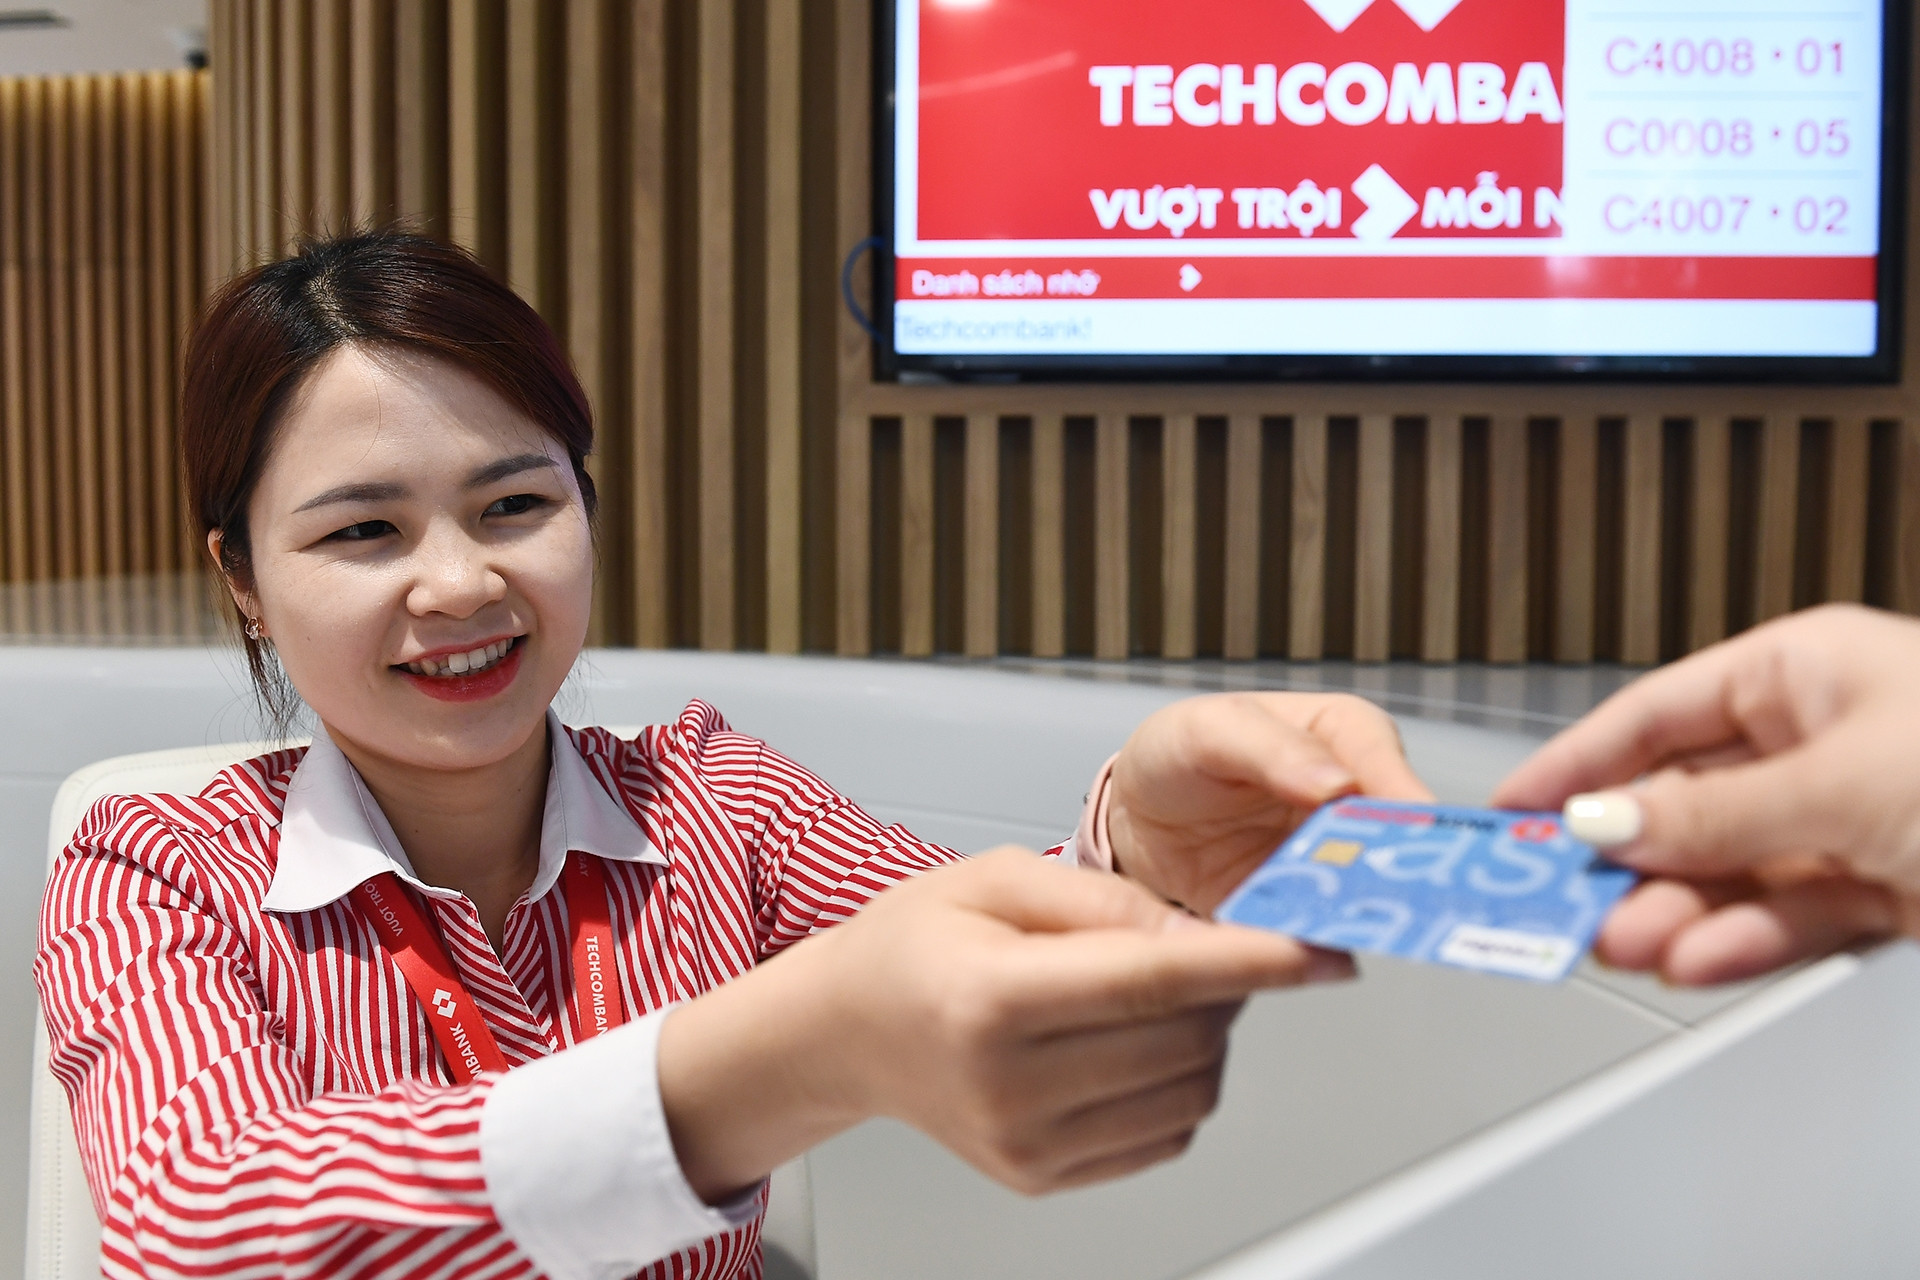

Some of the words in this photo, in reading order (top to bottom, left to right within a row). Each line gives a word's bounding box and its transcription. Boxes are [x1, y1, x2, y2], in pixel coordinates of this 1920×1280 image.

[1605, 37, 1754, 77] C4008
[1796, 37, 1844, 77] 01
[1088, 61, 1564, 126] TECHCOMBA
[1604, 117, 1754, 158] C0008
[1795, 117, 1850, 158] 05
[1088, 184, 1223, 238] VƯỢT
[1232, 179, 1342, 238] TRỘI
[1421, 170, 1522, 229] MỖI
[1603, 194, 1752, 236] C4007
[1794, 195, 1849, 236] 02
[911, 269, 979, 296] Danh
[981, 269, 1044, 296] sách
